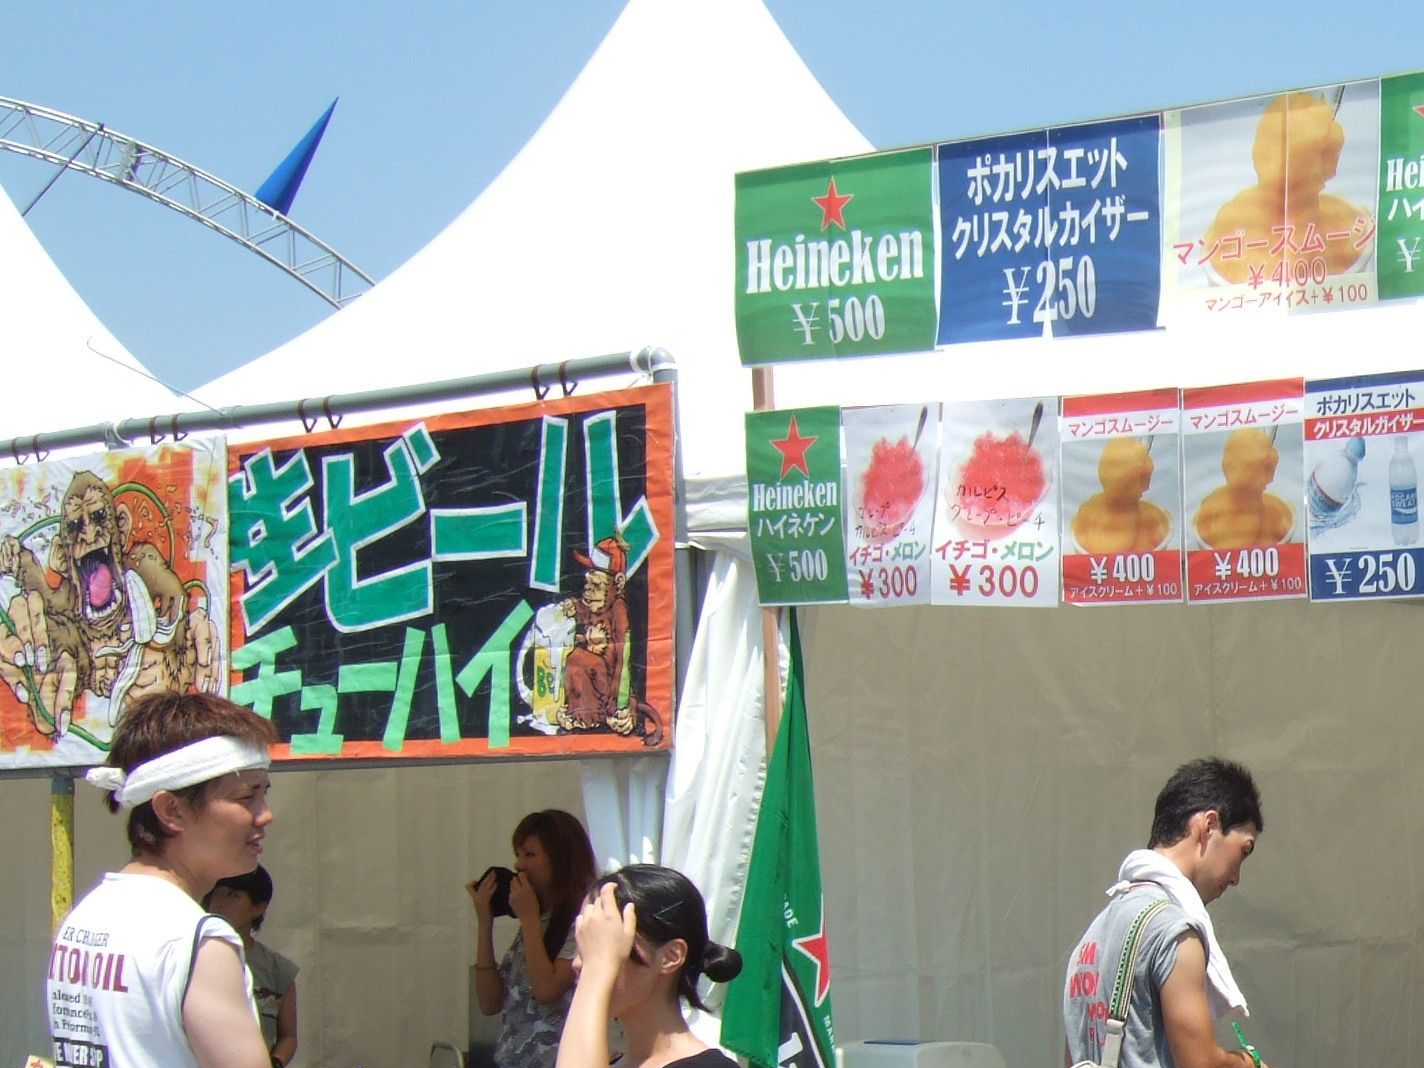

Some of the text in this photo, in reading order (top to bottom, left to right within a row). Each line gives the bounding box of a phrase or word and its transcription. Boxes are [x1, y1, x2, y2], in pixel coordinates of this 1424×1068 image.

[966, 136, 1129, 205] ポカリスエット
[951, 194, 1149, 260] クリスタルカイザー
[746, 226, 925, 295] Heineken
[1190, 404, 1299, 430] マンゴスムージー
[1316, 387, 1416, 416] ポカリスエット
[1068, 415, 1174, 438] マンゴスムージー
[753, 481, 837, 513] Heineken
[228, 411, 661, 635] 生ビール
[757, 513, 836, 540] ハイネケン
[934, 539, 1055, 564] イチゴ・メロン
[231, 599, 535, 756] チューハイ
